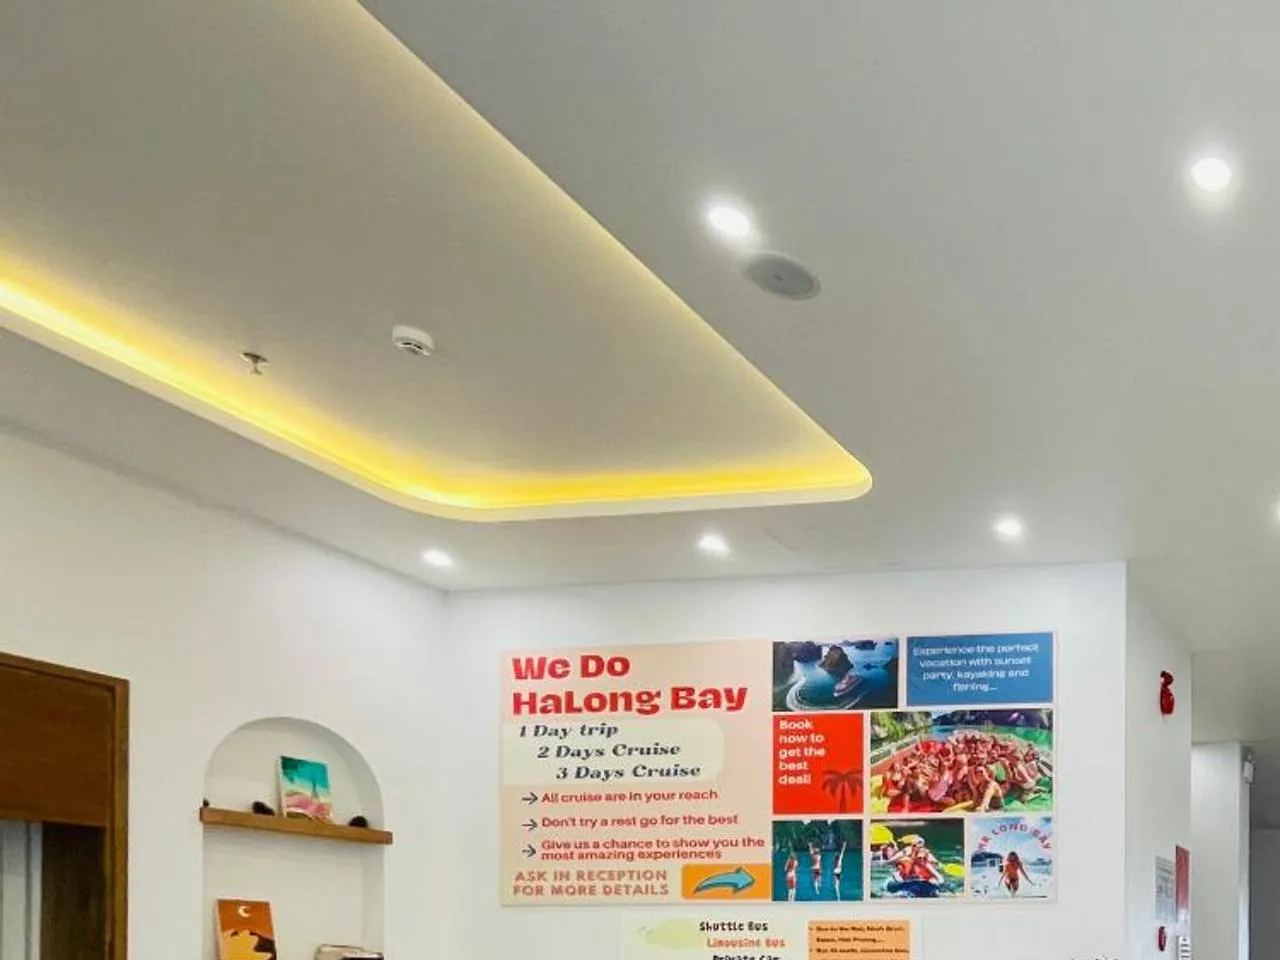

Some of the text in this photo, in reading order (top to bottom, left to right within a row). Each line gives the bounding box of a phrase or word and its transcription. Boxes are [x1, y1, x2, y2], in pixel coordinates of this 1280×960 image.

[976, 645, 995, 654] the
[997, 643, 1040, 654] perfect
[512, 655, 630, 680] We Do
[919, 656, 1032, 668] vacation with sunset
[956, 670, 1006, 680] kayaking
[1008, 669, 1029, 677] and
[513, 686, 748, 716] HaLong Bay
[520, 722, 619, 739] 1 Day trip
[779, 719, 814, 730] Book
[779, 733, 825, 743] now to
[537, 743, 681, 760] 2 Days Cruise
[779, 747, 826, 759] get the
[779, 761, 809, 770] best
[556, 764, 701, 781] 3 Days Cruise
[778, 774, 812, 784] deal!
[541, 789, 718, 804] All cruise are in your reach
[541, 814, 738, 829] Don't try a rest go for the best
[541, 836, 765, 850] Give us a chance to show you the
[541, 849, 722, 862] most amazing experiences
[514, 869, 668, 881] ASK IN RECEPTION
[513, 883, 669, 896] FOR MORE DETAILS
[699, 921, 769, 932] Shuttle Bus
[707, 938, 786, 948] Limousine Bus
